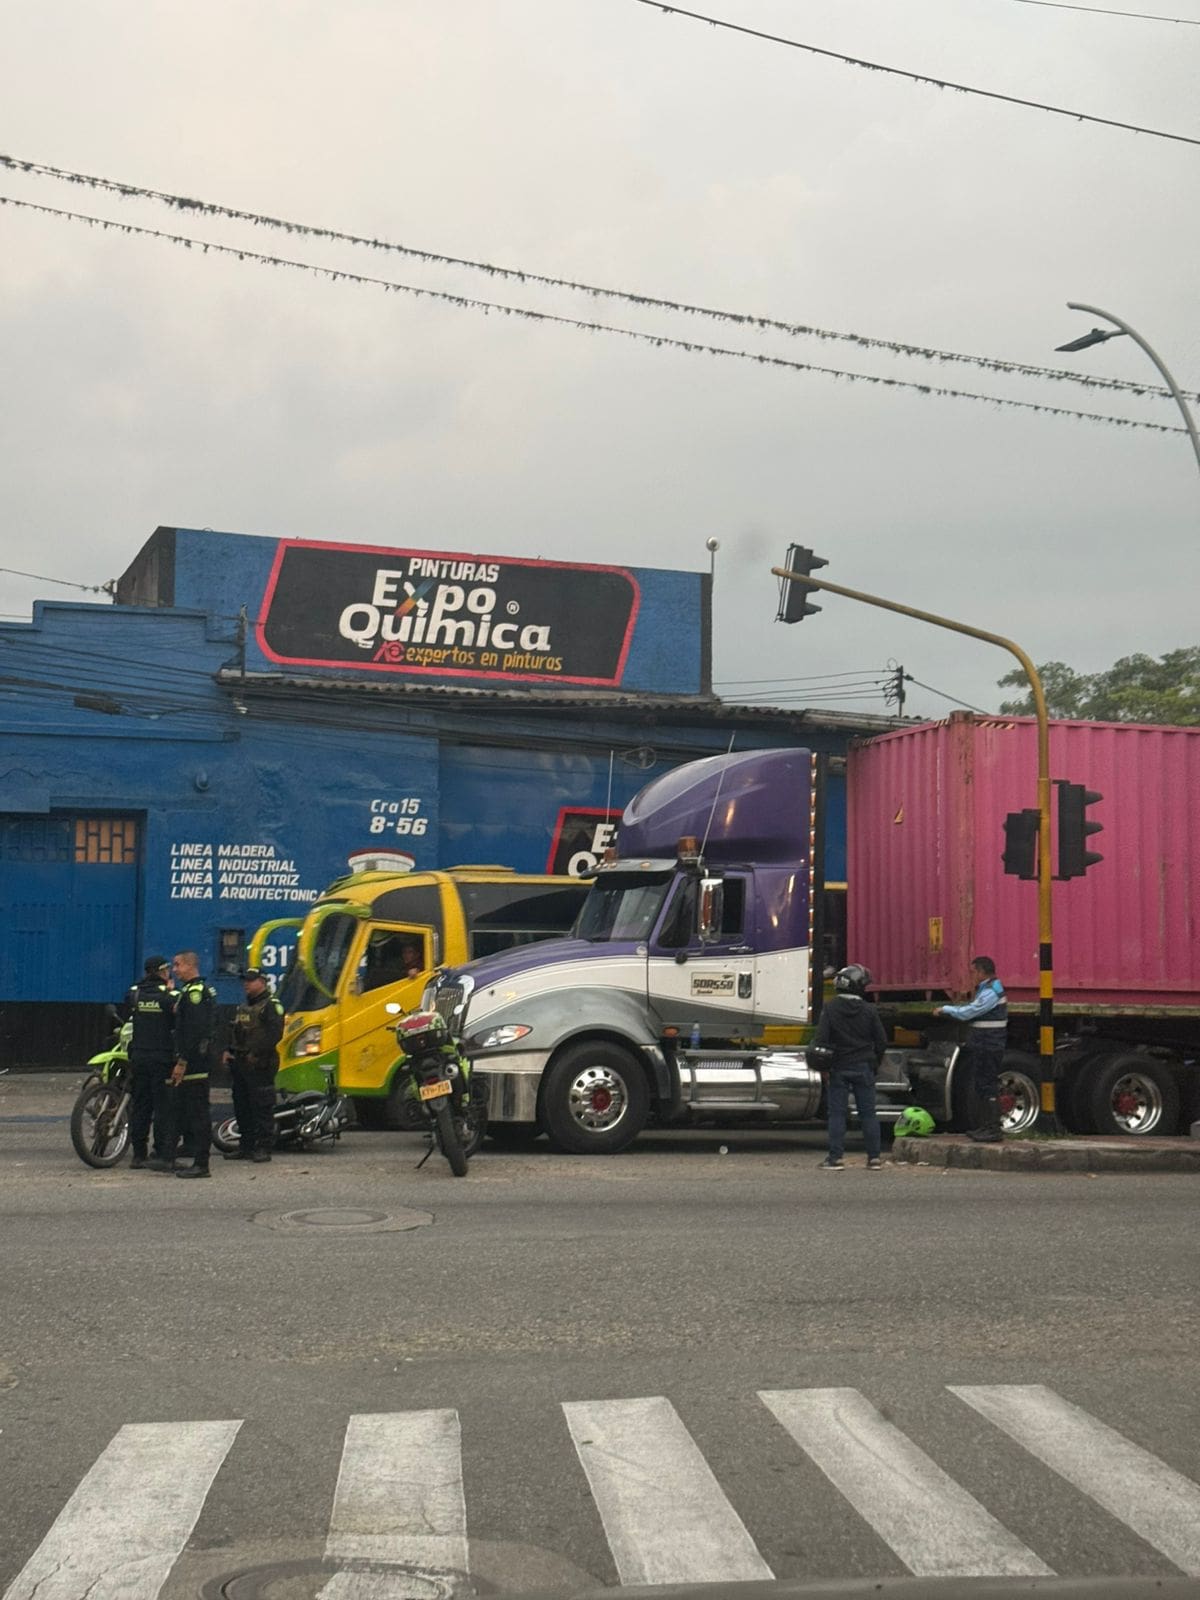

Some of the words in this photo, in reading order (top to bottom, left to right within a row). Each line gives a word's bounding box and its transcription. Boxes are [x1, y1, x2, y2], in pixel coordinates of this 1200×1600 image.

[408, 557, 500, 582] PINTURAS
[372, 569, 497, 615] Expo
[406, 645, 476, 666] expertos
[480, 652, 498, 667] en
[502, 651, 563, 671] pinturas
[369, 816, 429, 835] 8-56
[170, 843, 213, 857] LINEA
[218, 844, 275, 858] MADERA
[170, 857, 213, 871] LINEA
[218, 858, 297, 873] INDUSTRIAL
[170, 871, 213, 885] LINEA
[218, 872, 301, 886] AUTOMOTRIZ
[170, 886, 213, 899] LINEA
